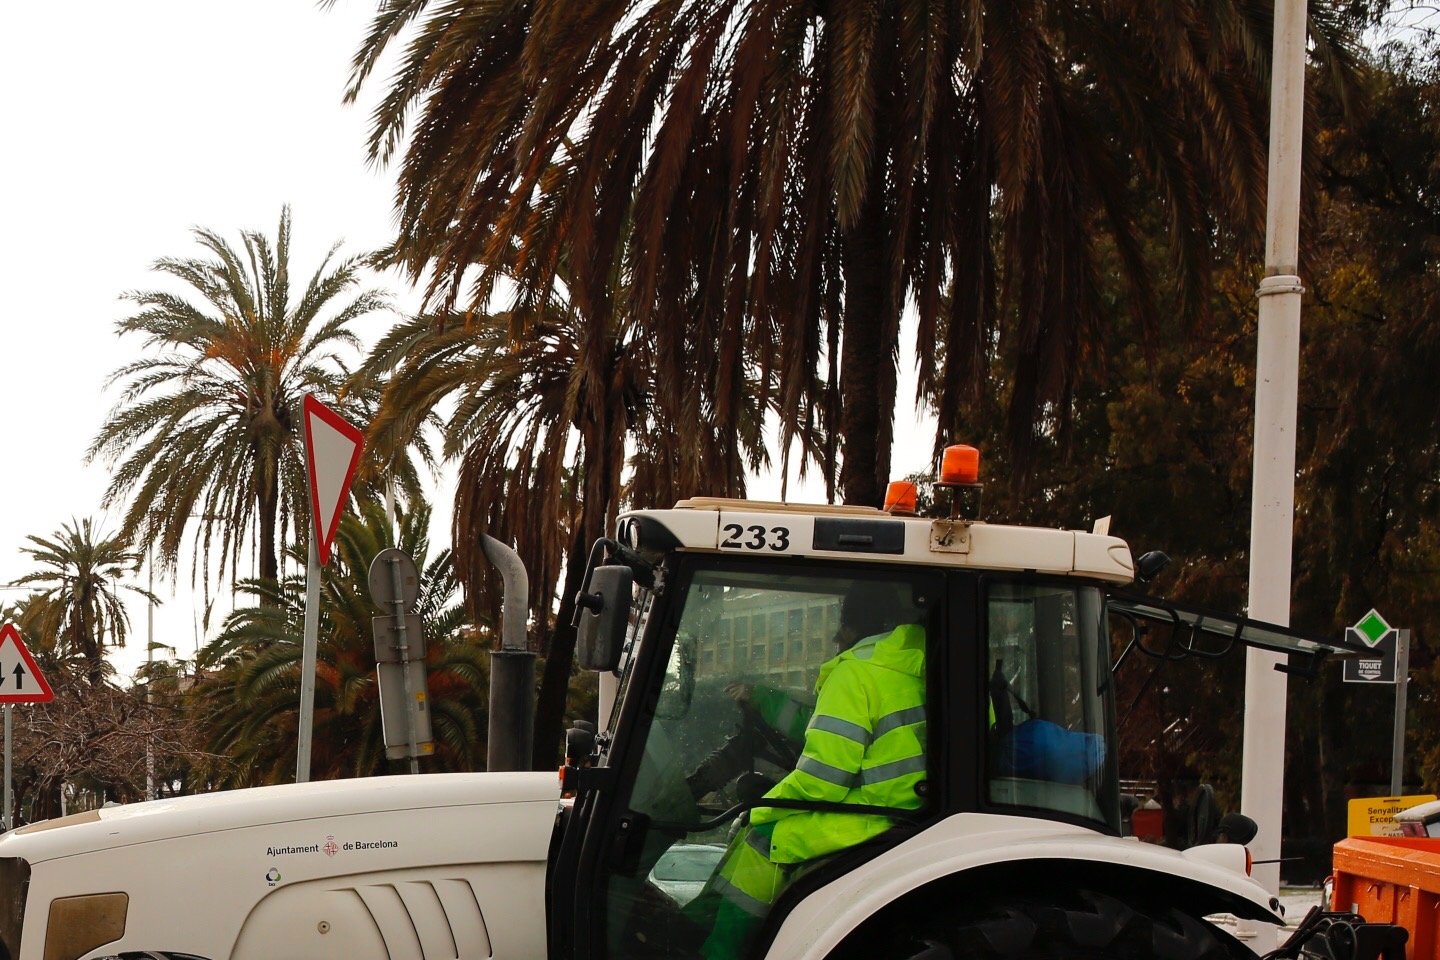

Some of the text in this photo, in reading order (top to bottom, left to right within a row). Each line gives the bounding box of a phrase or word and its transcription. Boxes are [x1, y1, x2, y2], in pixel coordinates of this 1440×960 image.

[720, 523, 790, 552] 233
[1359, 662, 1382, 670] TIQUET
[266, 840, 398, 857] Ajuntament de Barcelona
